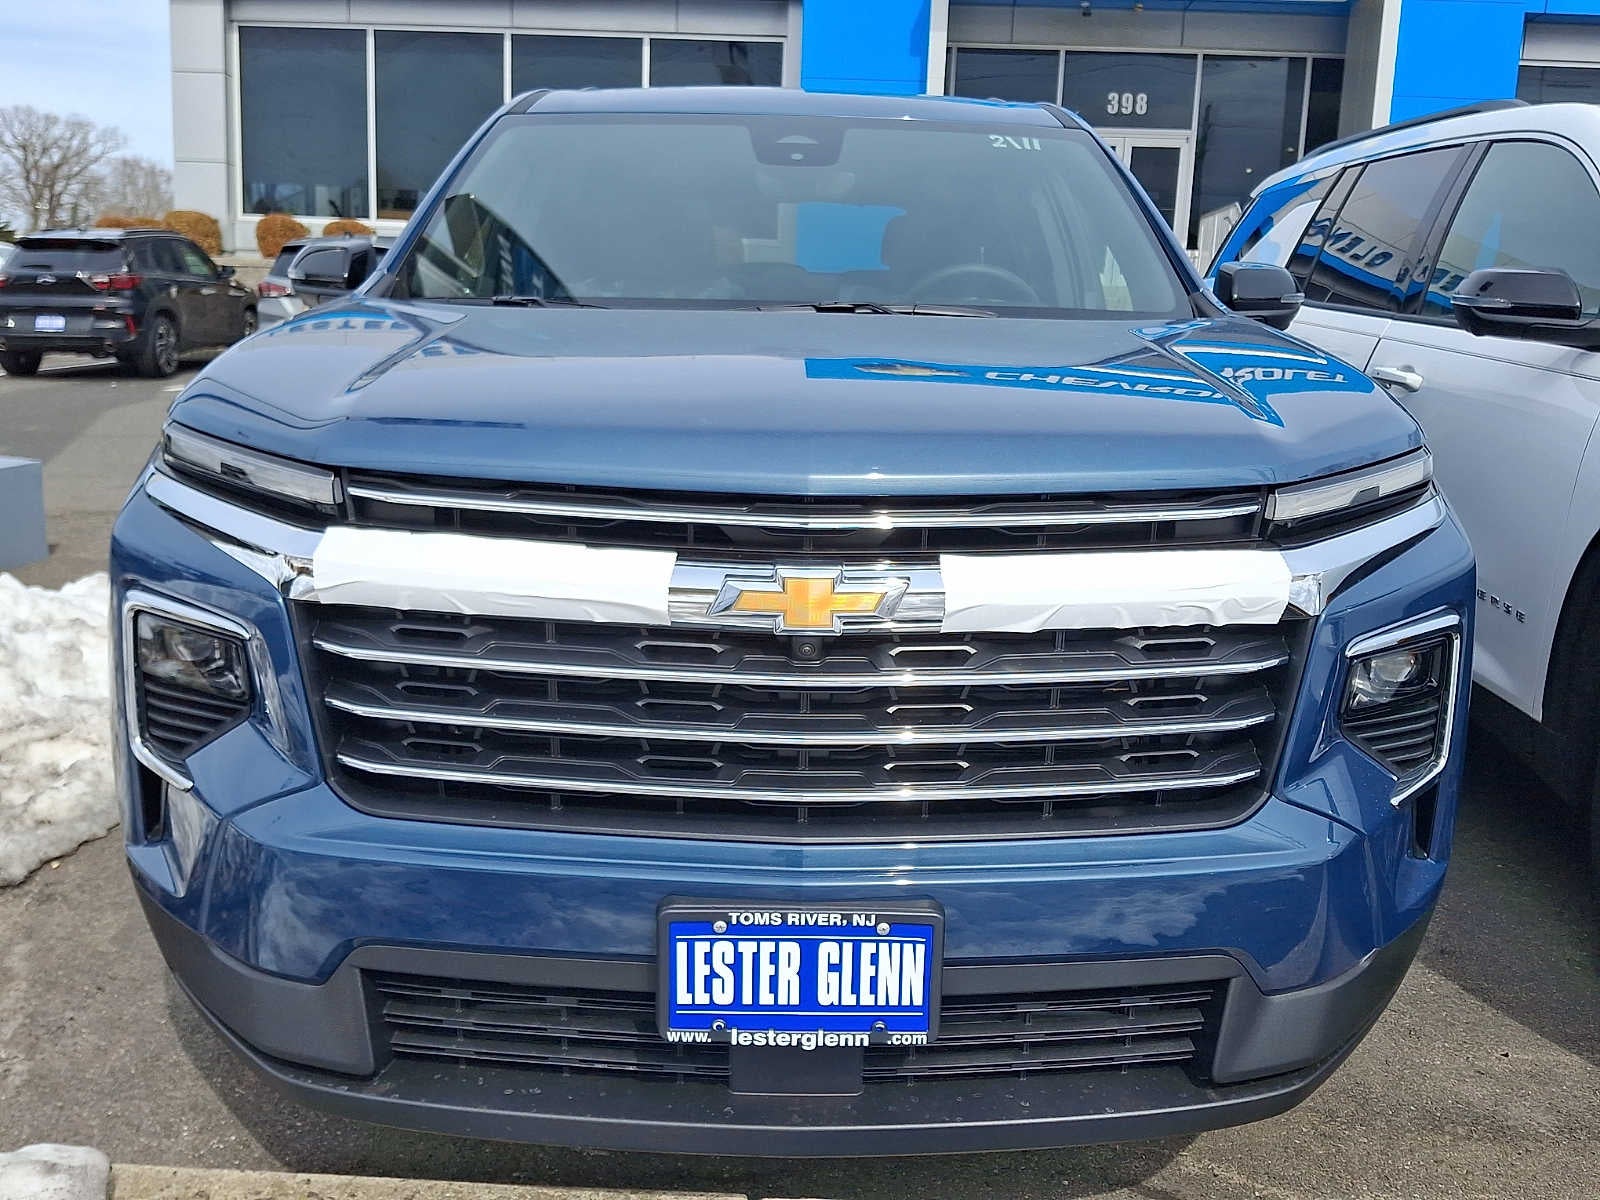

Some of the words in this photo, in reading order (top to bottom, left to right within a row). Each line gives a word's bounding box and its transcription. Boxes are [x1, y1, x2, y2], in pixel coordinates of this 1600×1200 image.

[1107, 92, 1148, 115] 398
[728, 912, 782, 926] TOMS
[787, 912, 848, 928] RIVER,
[852, 913, 876, 927] NJ
[676, 940, 800, 1006] LESTER
[817, 941, 926, 1007] GLENN
[666, 1030, 712, 1044] www.
[730, 1028, 869, 1051] lesterglenn
[887, 1030, 928, 1046] .com
